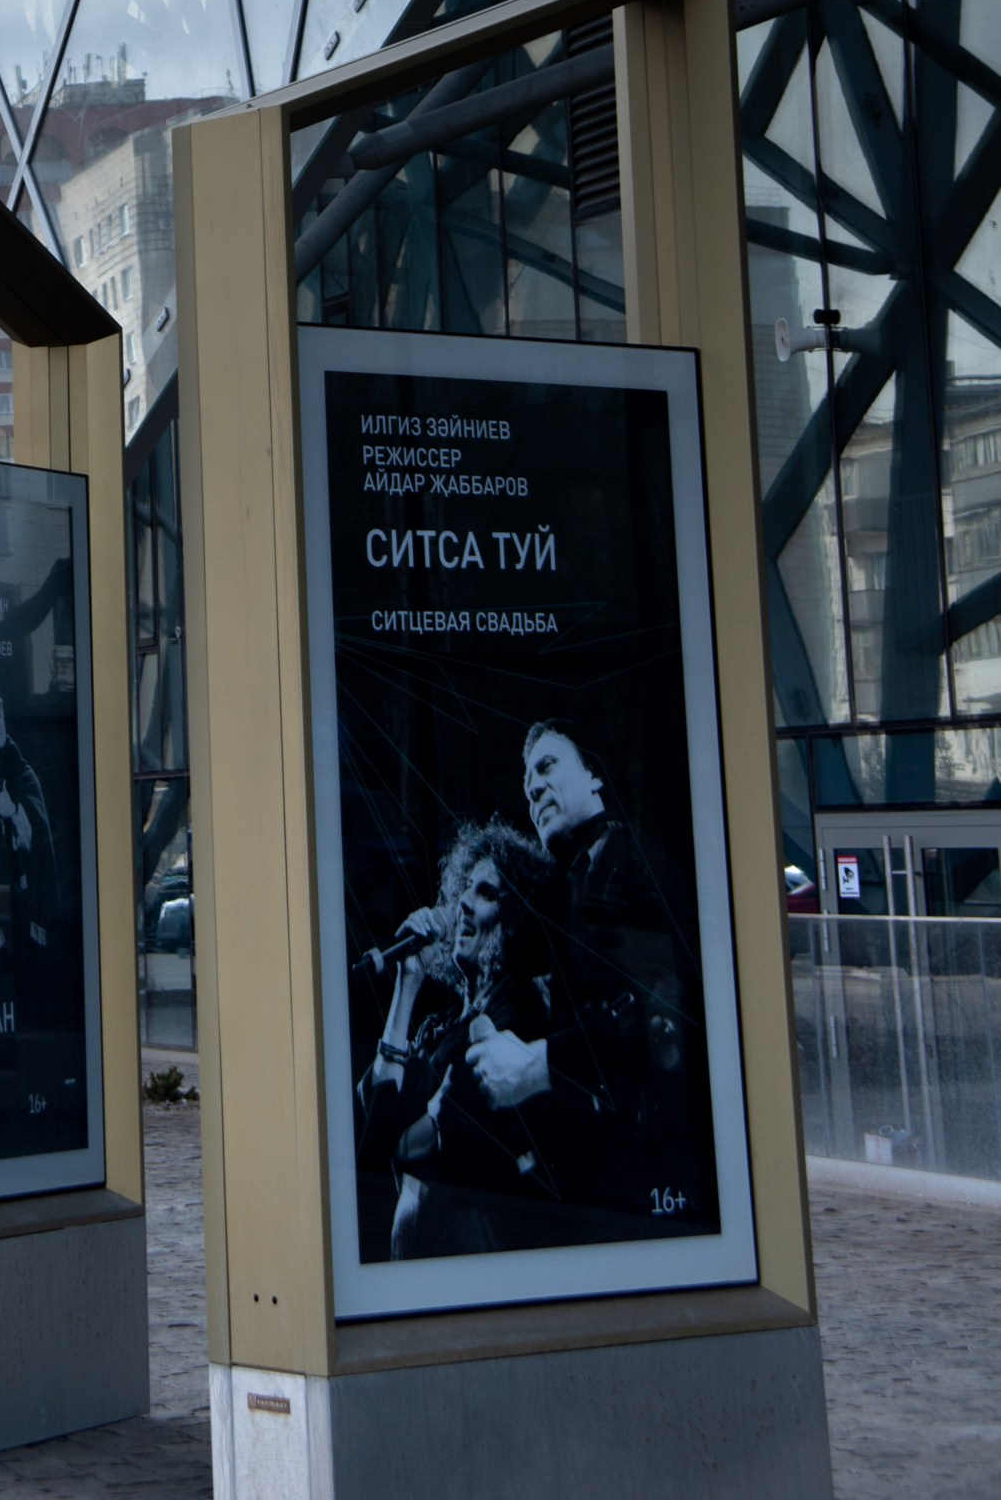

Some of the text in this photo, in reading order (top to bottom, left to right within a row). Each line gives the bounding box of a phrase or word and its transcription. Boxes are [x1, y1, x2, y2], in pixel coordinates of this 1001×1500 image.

[361, 414, 511, 440] ИЛГИЗ ЗӘЙНИЕВ
[362, 445, 462, 467] РЕЖИССЕР
[363, 469, 528, 497] АЙДАР ҖАББАРОВ
[366, 524, 556, 571] СИТСА ТУЙ
[371, 610, 558, 636] СИТЦЕВАЯ СВАДЬБА
[28, 1093, 47, 1114] 16+
[649, 1186, 687, 1213] 16+
